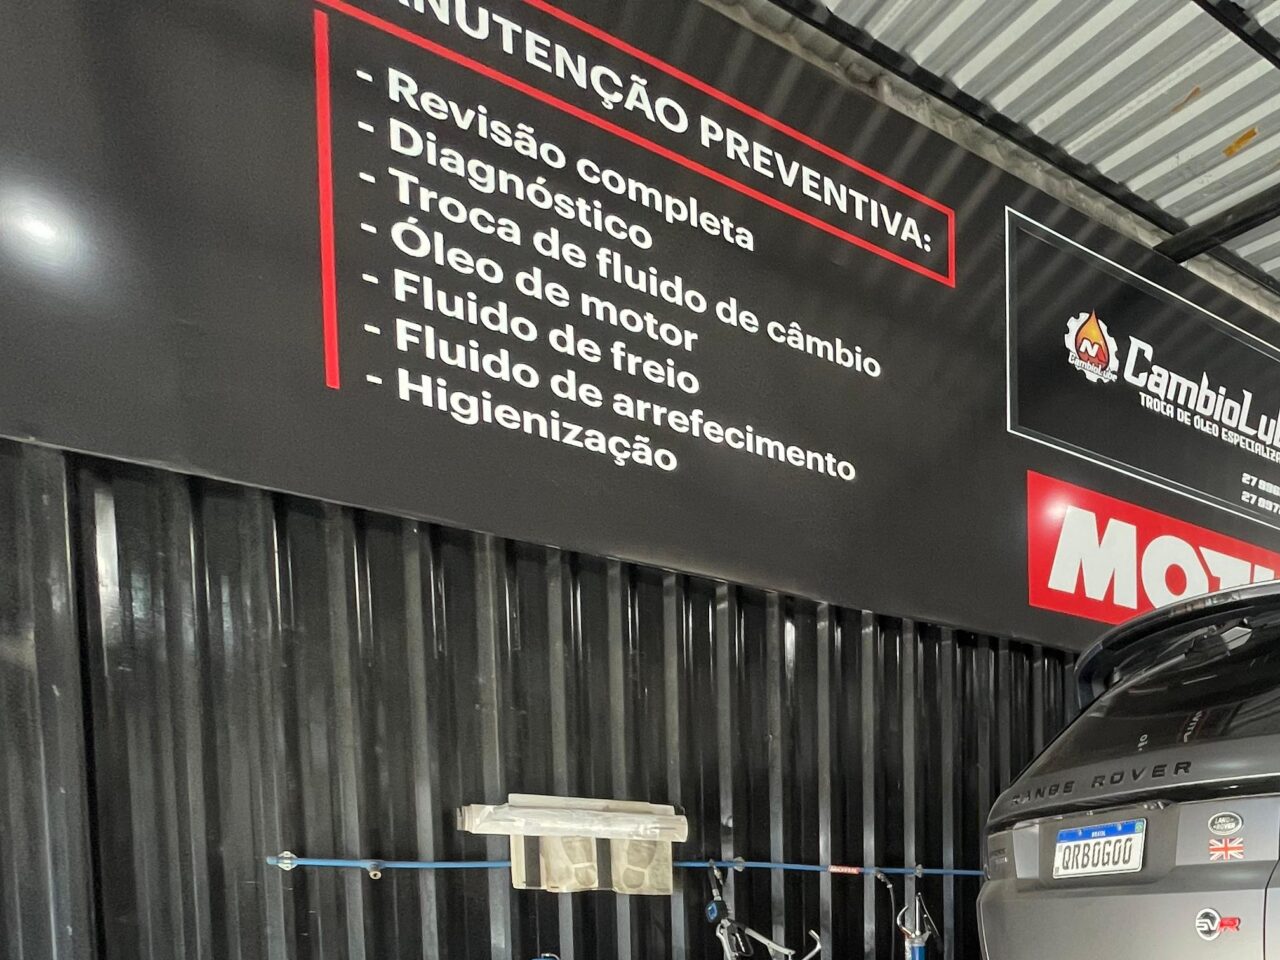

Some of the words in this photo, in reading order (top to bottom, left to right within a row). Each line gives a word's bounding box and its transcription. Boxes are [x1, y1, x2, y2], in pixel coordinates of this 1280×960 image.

[388, 67, 567, 169] Revisão
[576, 158, 754, 252] completa
[389, 117, 653, 250] Diagnóstico
[398, 0, 689, 134] NUTENÇÃO
[700, 114, 932, 253] PREVENTIVA:
[387, 166, 521, 246] Troca
[532, 226, 587, 269] de
[595, 247, 708, 314] fluido
[715, 296, 760, 334] de
[766, 321, 882, 378] câmbio
[390, 216, 504, 284] Óleo
[515, 266, 570, 308] de
[581, 292, 699, 352] motor
[393, 268, 538, 342] Fluido
[548, 323, 602, 363] de
[610, 340, 700, 394] freio
[395, 317, 540, 389] Fluido
[550, 368, 603, 408] de
[612, 393, 856, 481] arrefecimento
[397, 367, 678, 472] Higienização
[1139, 391, 1174, 419] TROCA
[1177, 409, 1191, 426] DE
[1193, 413, 1219, 438] ÓLEO
[1241, 472, 1258, 487] 27
[1241, 490, 1258, 505] 27
[1091, 761, 1192, 789] ROVER
